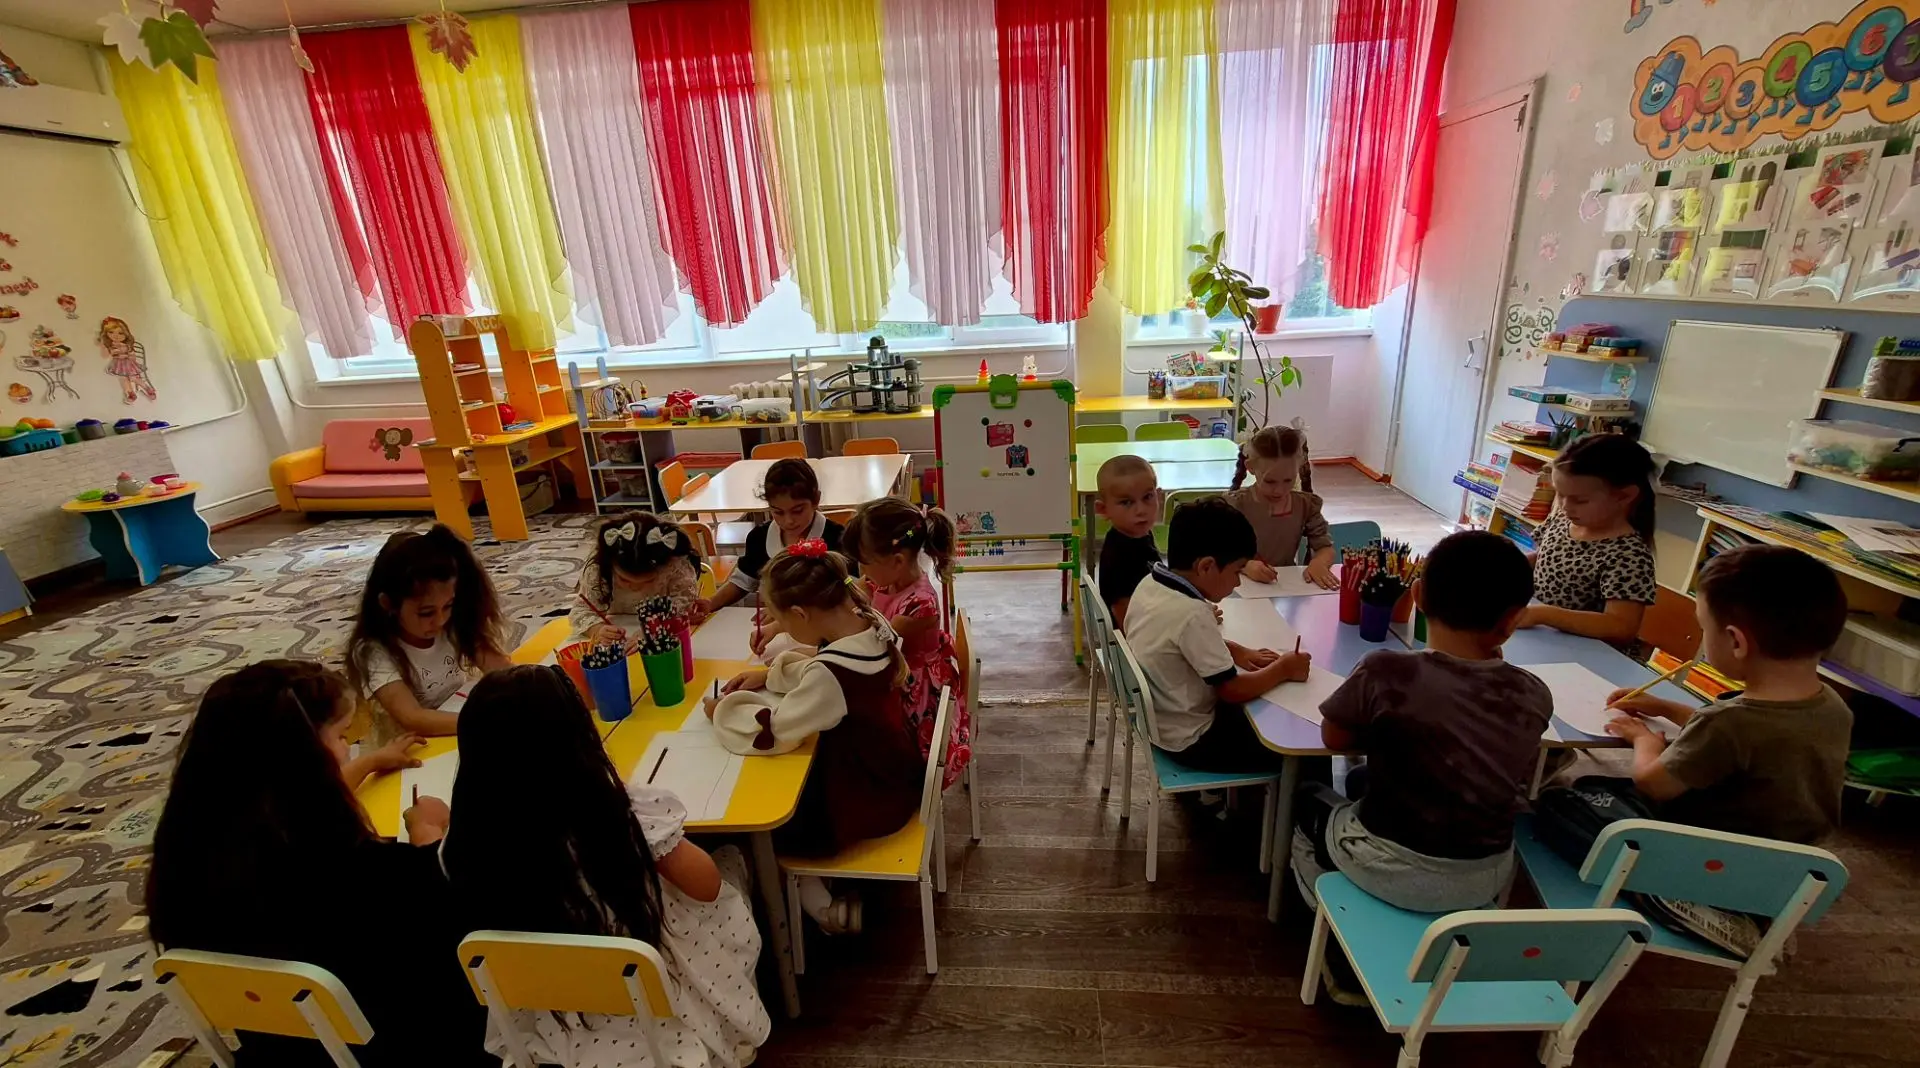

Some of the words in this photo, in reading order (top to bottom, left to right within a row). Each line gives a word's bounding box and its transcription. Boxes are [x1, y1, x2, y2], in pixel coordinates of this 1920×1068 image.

[1671, 94, 1685, 119] 1
[1703, 76, 1724, 103] 2
[1736, 79, 1756, 107] 3
[1774, 55, 1798, 83] 4
[1809, 62, 1833, 92] 5
[1861, 24, 1887, 55] 6
